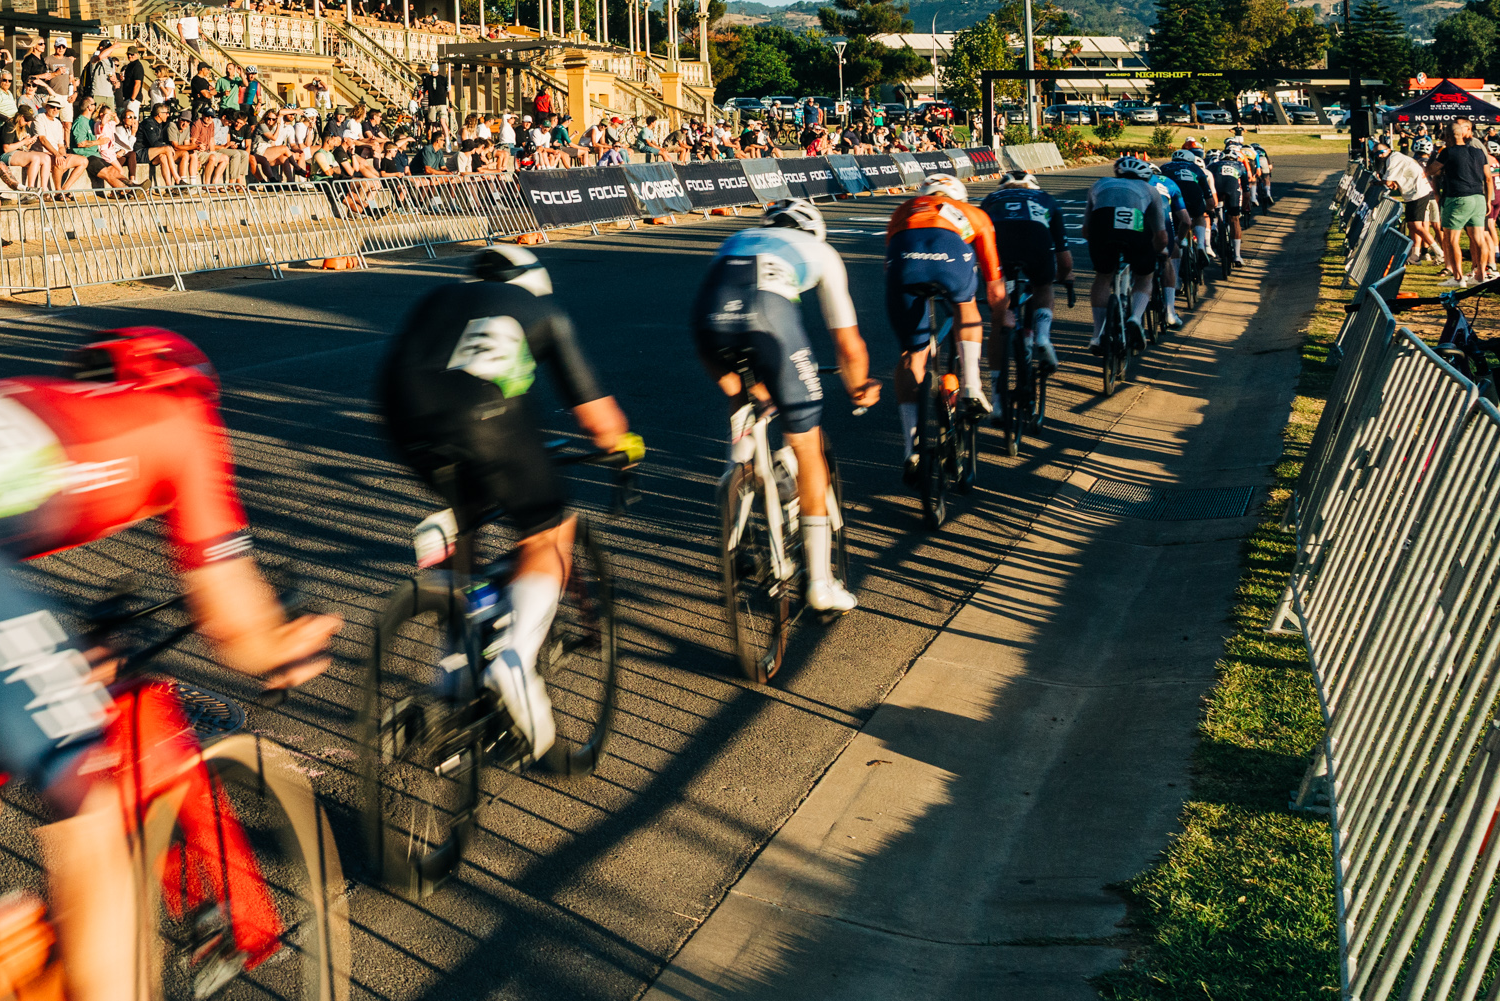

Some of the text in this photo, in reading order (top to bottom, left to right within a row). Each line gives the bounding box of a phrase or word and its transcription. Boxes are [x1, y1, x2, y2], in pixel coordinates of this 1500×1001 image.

[784, 172, 806, 184] FOCUS
[810, 170, 833, 181] FOCUS
[881, 164, 898, 175] FOCUS
[685, 179, 715, 191] FOCUS
[718, 176, 748, 189] FOCUS
[530, 189, 582, 205] FOCUS
[588, 185, 628, 201] FOCUS
[1116, 210, 1133, 226] 40
